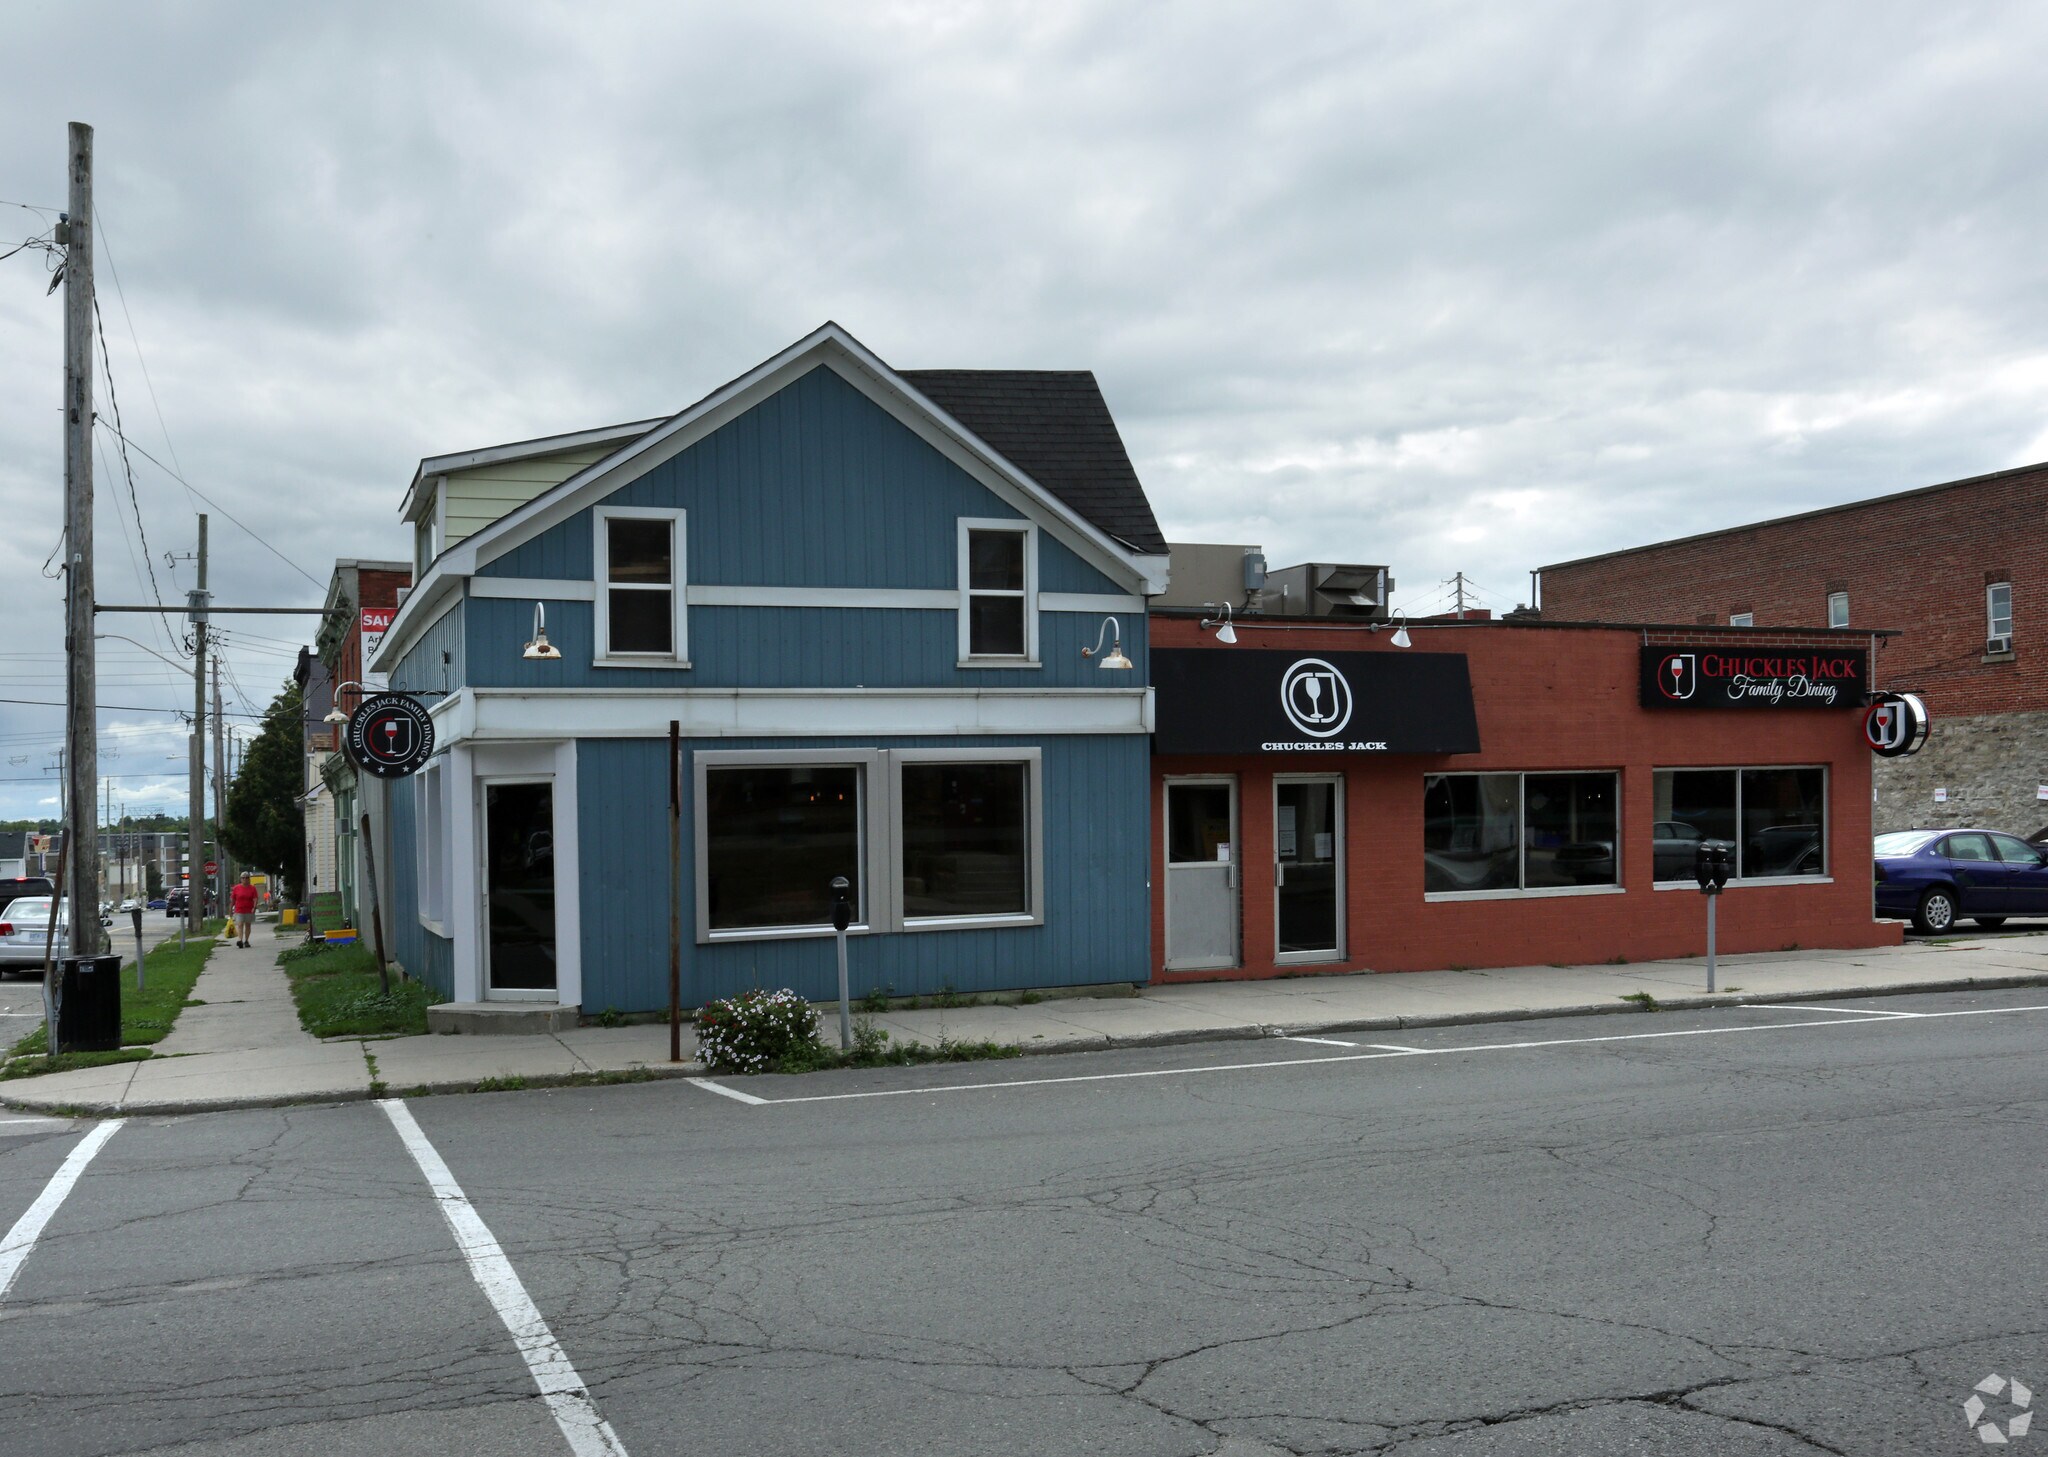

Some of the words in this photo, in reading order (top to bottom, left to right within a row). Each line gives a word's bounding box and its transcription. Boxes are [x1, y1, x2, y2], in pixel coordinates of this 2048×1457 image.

[363, 615, 391, 626] SAL
[1727, 673, 1785, 705] Family
[1787, 674, 1838, 705] Dining
[353, 703, 377, 748] CHUCKLES
[376, 697, 399, 710] JACK
[400, 699, 428, 722] FAMILY
[420, 724, 432, 757] DINING
[1261, 742, 1345, 751] CHUCKLES
[1348, 742, 1387, 751] JACK
